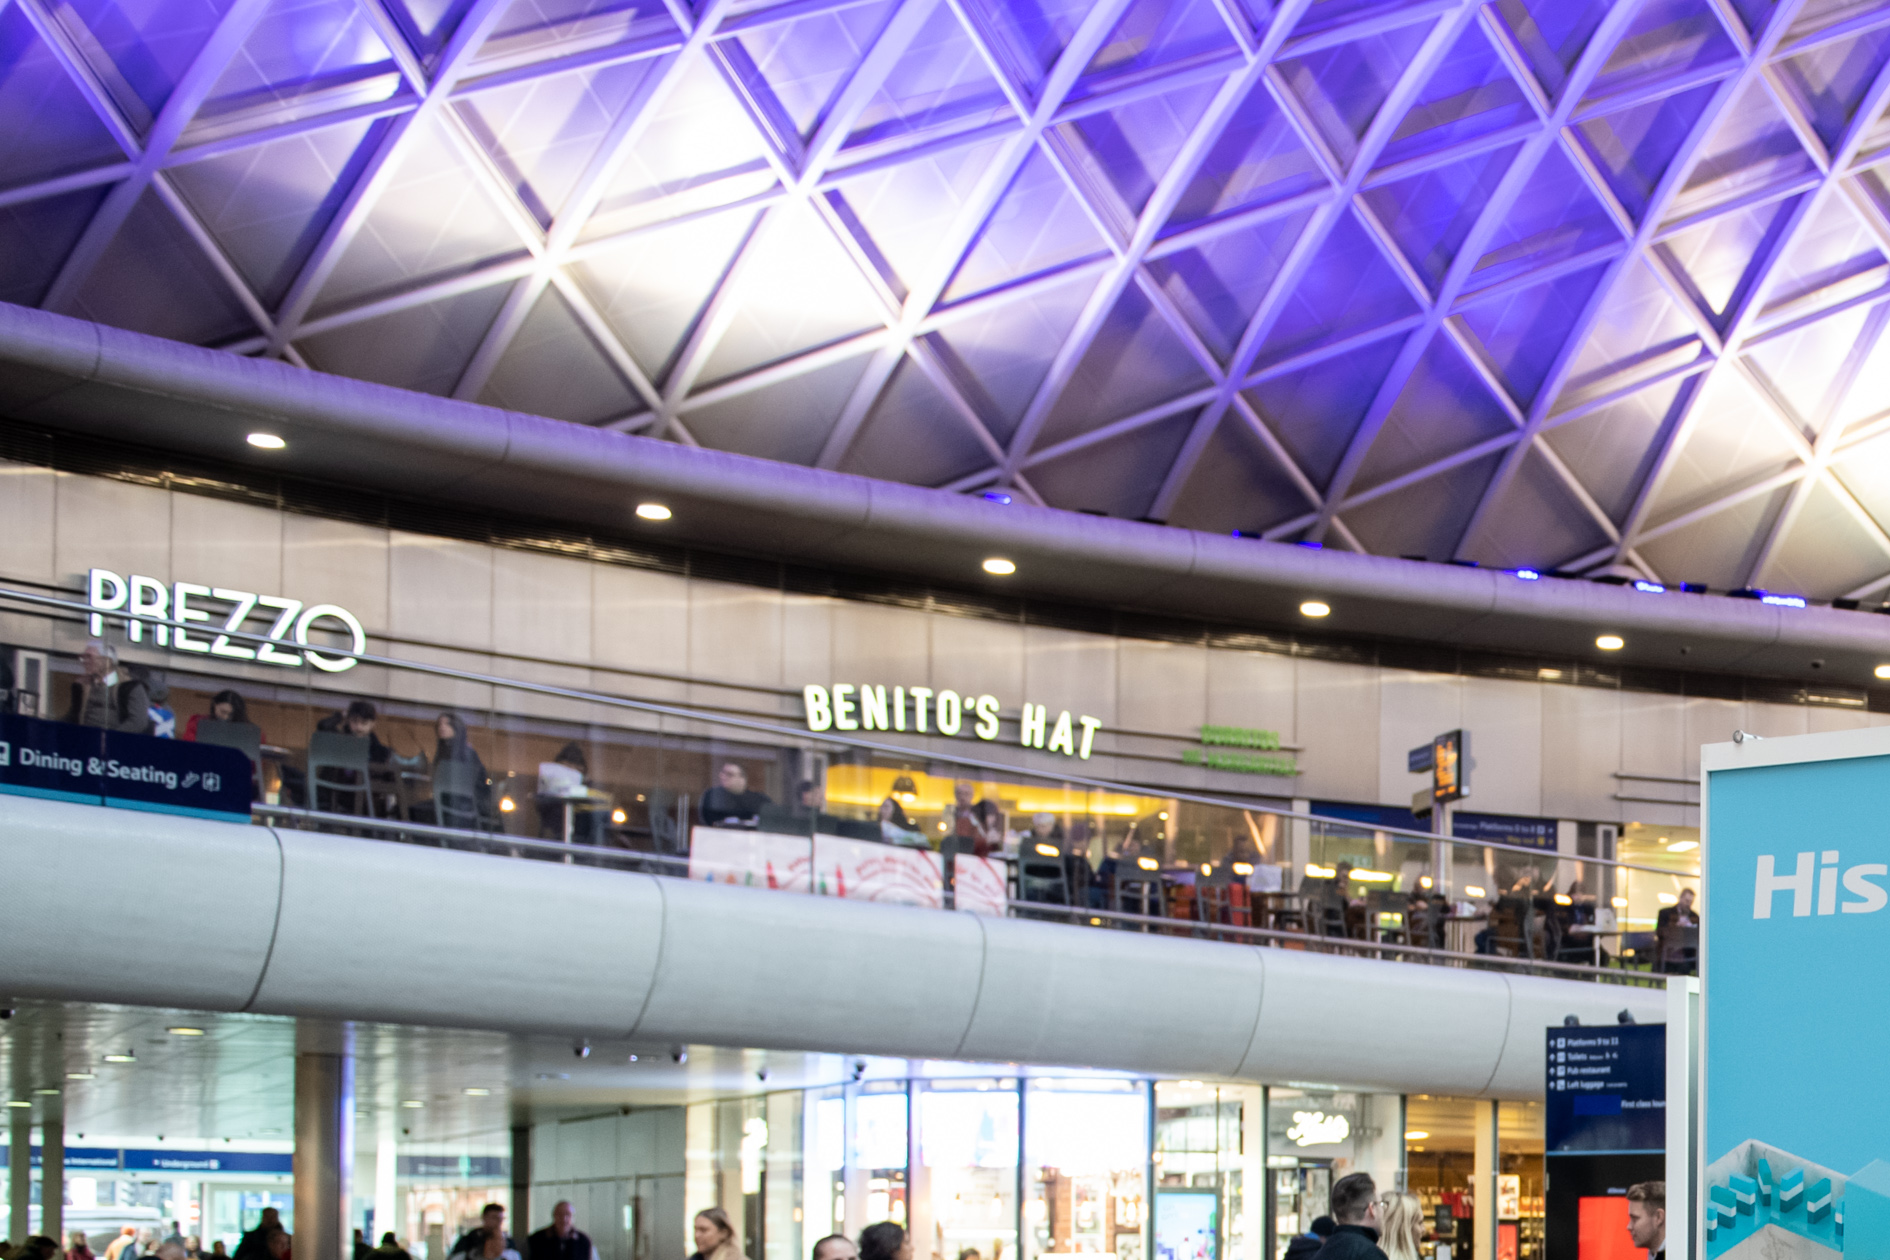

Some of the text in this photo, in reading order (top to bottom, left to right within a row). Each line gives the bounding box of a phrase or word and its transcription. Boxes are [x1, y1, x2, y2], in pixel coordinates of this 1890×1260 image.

[90, 568, 366, 672] PREZZO
[804, 683, 1102, 759] BENITO'S HAT
[19, 747, 178, 790] Dining & Seating
[1567, 1038, 1597, 1047] Platforms
